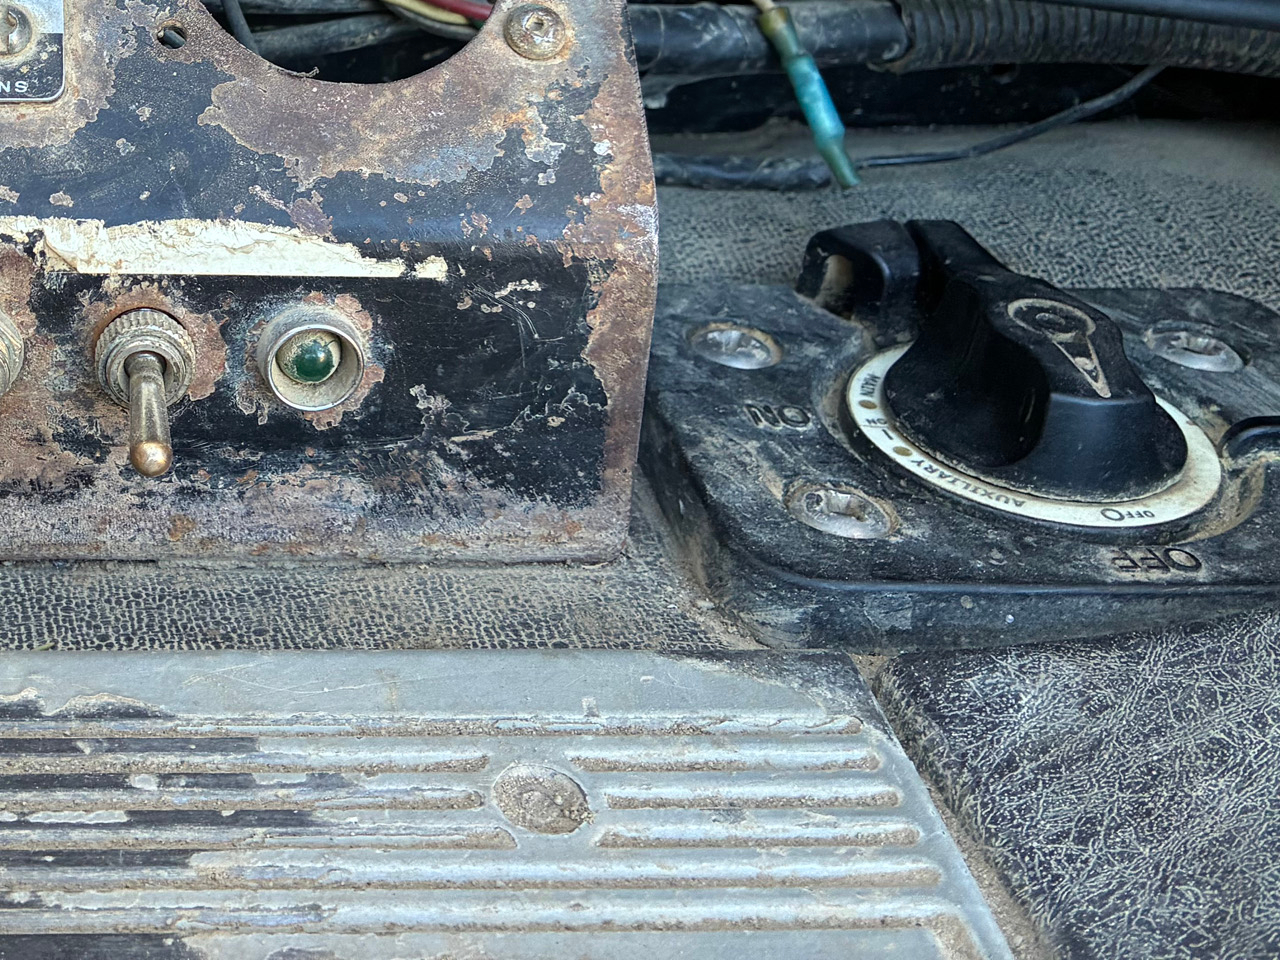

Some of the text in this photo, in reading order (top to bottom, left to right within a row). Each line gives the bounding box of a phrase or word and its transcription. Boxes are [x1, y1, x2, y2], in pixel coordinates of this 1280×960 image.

[744, 403, 811, 428] ON
[910, 459, 1027, 509] AUXILIARY
[1110, 547, 1203, 573] OFF
